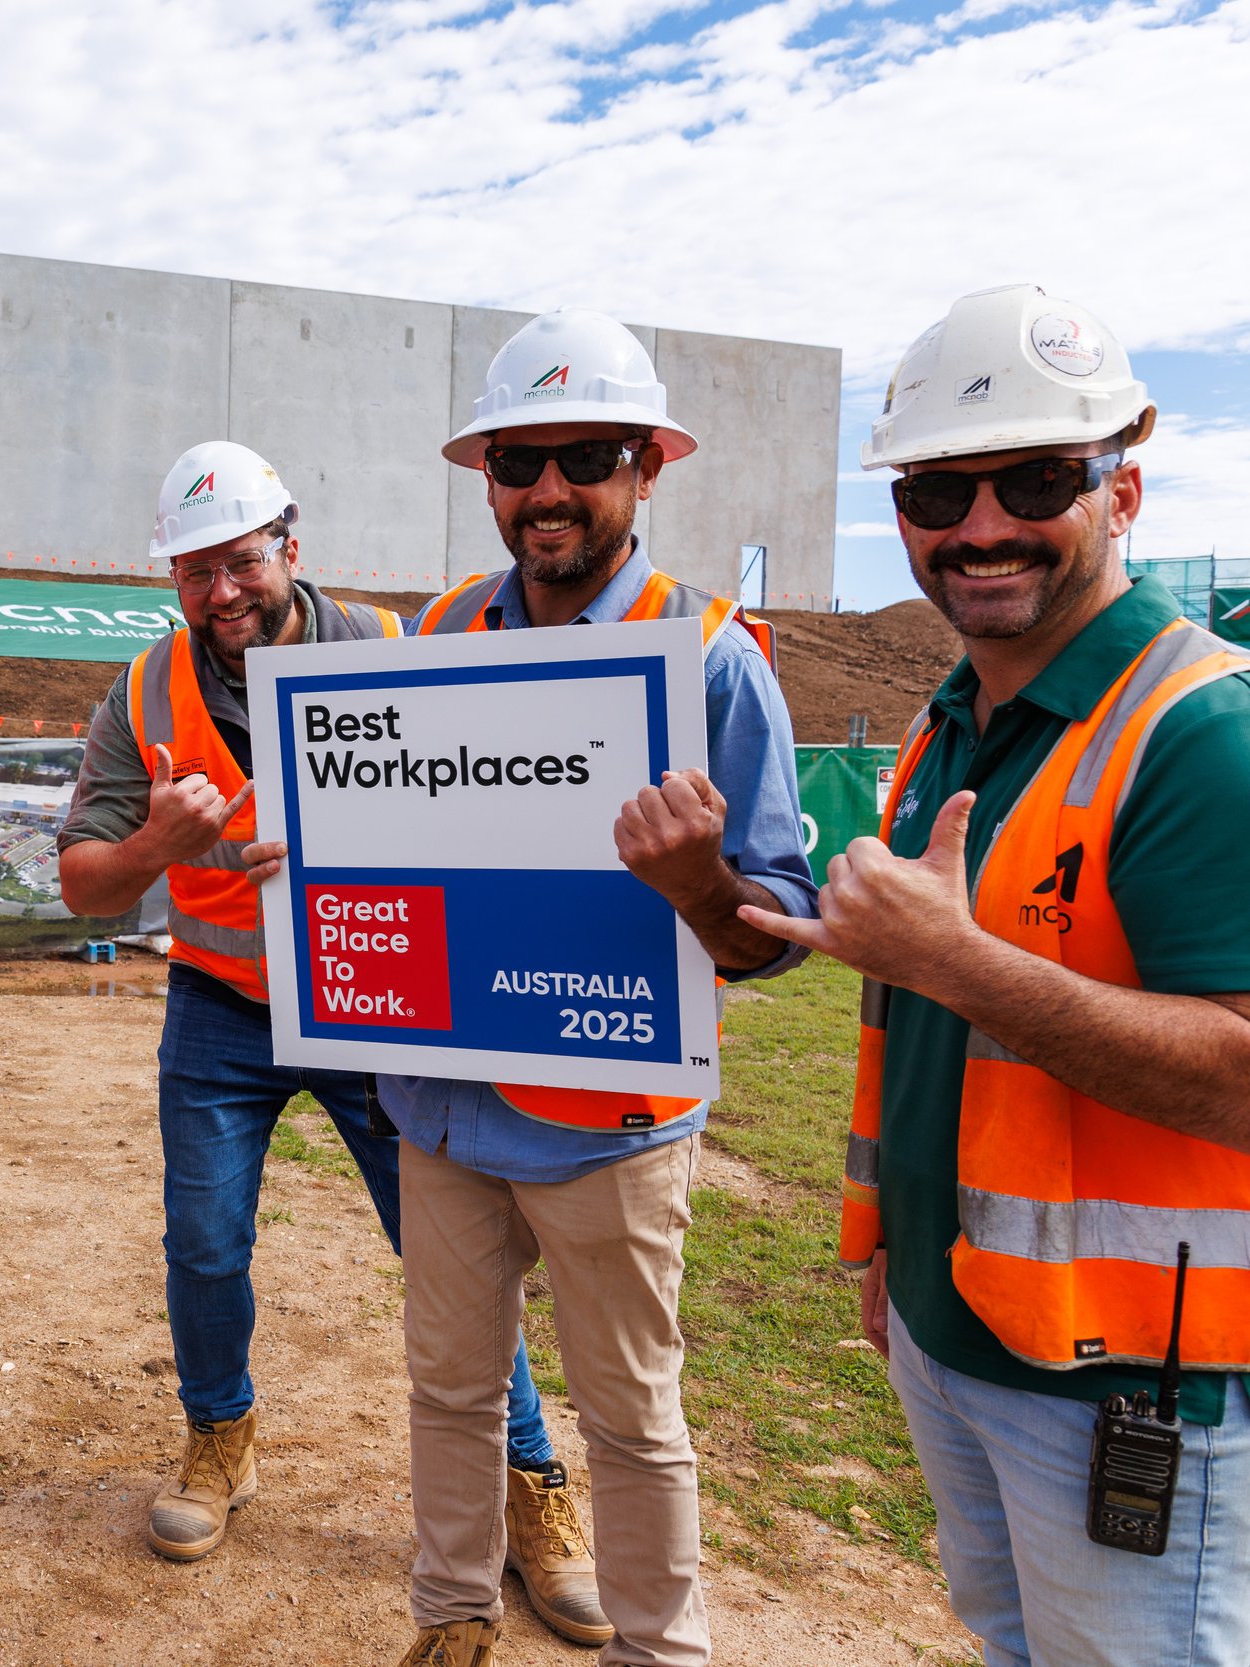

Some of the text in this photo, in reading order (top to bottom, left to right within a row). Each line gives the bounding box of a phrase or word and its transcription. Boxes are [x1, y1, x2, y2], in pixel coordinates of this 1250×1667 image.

[524, 386, 565, 399] mcnab
[958, 391, 989, 402] mcnab
[179, 493, 214, 511] mcnab
[305, 704, 401, 743] Best
[315, 894, 409, 922] Great
[320, 925, 410, 953] Place
[320, 956, 355, 981] To
[491, 970, 654, 1000] AUSTRALIA
[559, 1008, 655, 1043] 2025
